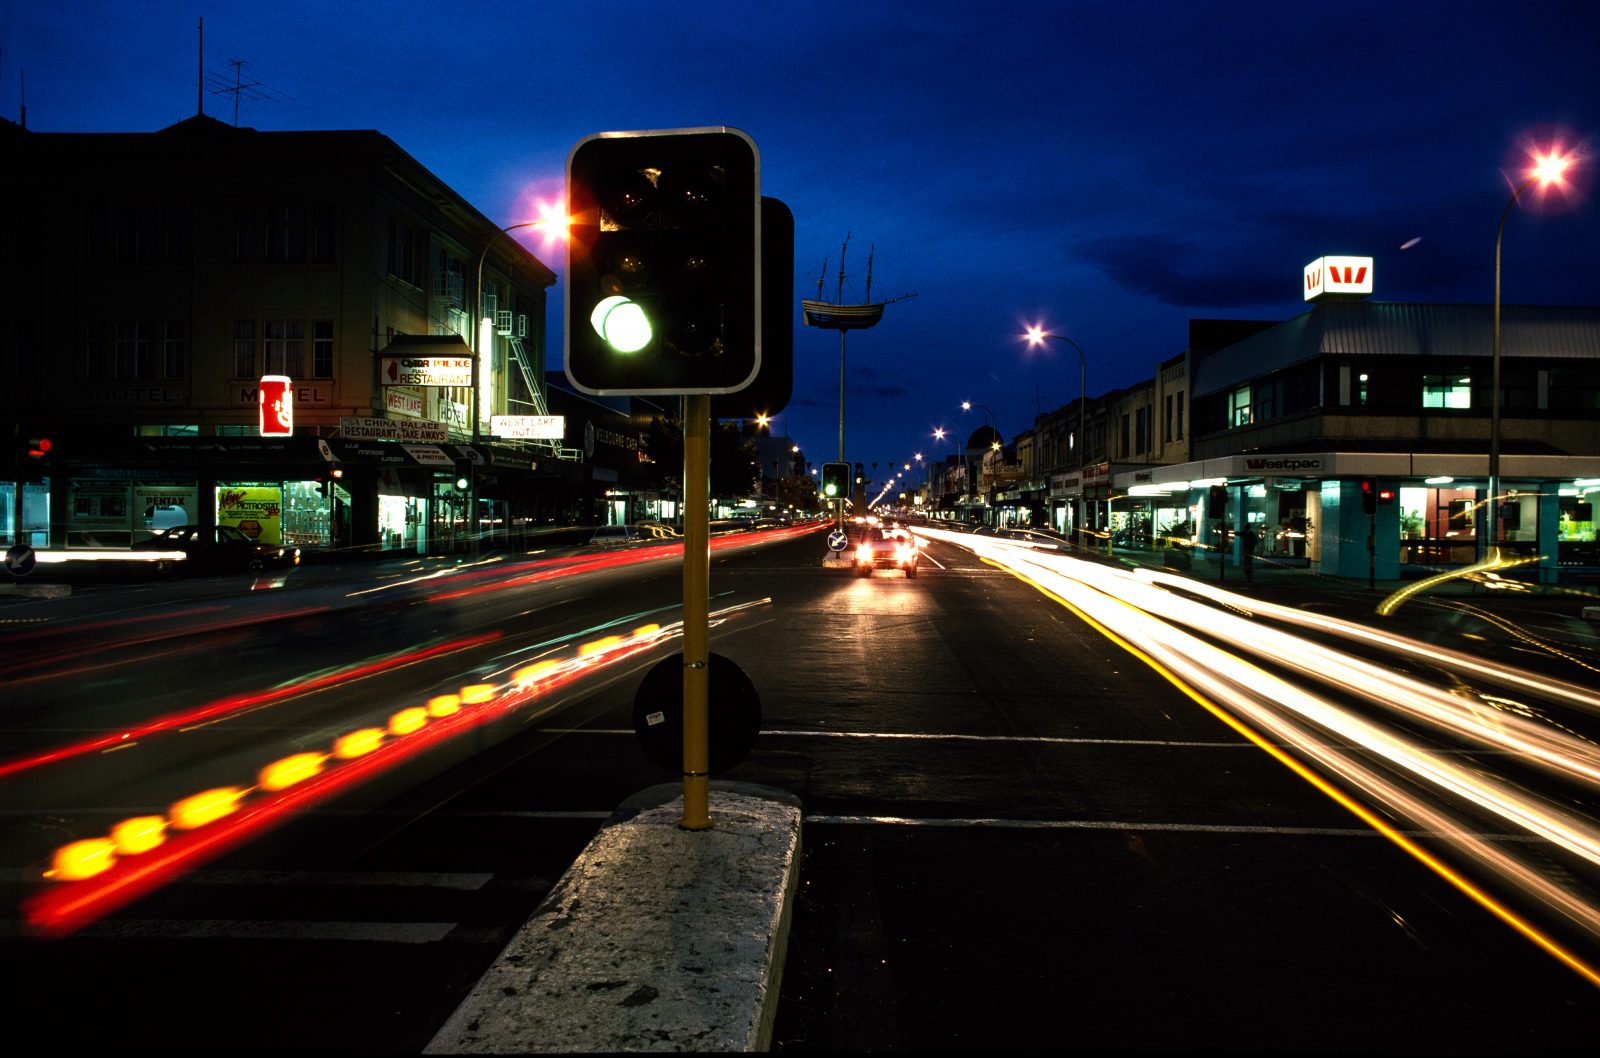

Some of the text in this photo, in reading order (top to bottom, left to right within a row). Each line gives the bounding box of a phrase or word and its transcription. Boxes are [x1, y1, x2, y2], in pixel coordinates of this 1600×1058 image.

[400, 374, 470, 385] RESTAURANT
[240, 388, 325, 402] MEL
[388, 394, 405, 409] WEST
[441, 405, 465, 424] HOTEL
[365, 418, 439, 430] CHINA PALACE
[345, 426, 397, 439] RESTAURANT
[401, 428, 419, 439] TAKE
[420, 430, 445, 440] AWAYS
[1246, 459, 1320, 471] Westpac
[146, 496, 185, 505] PENTAX
